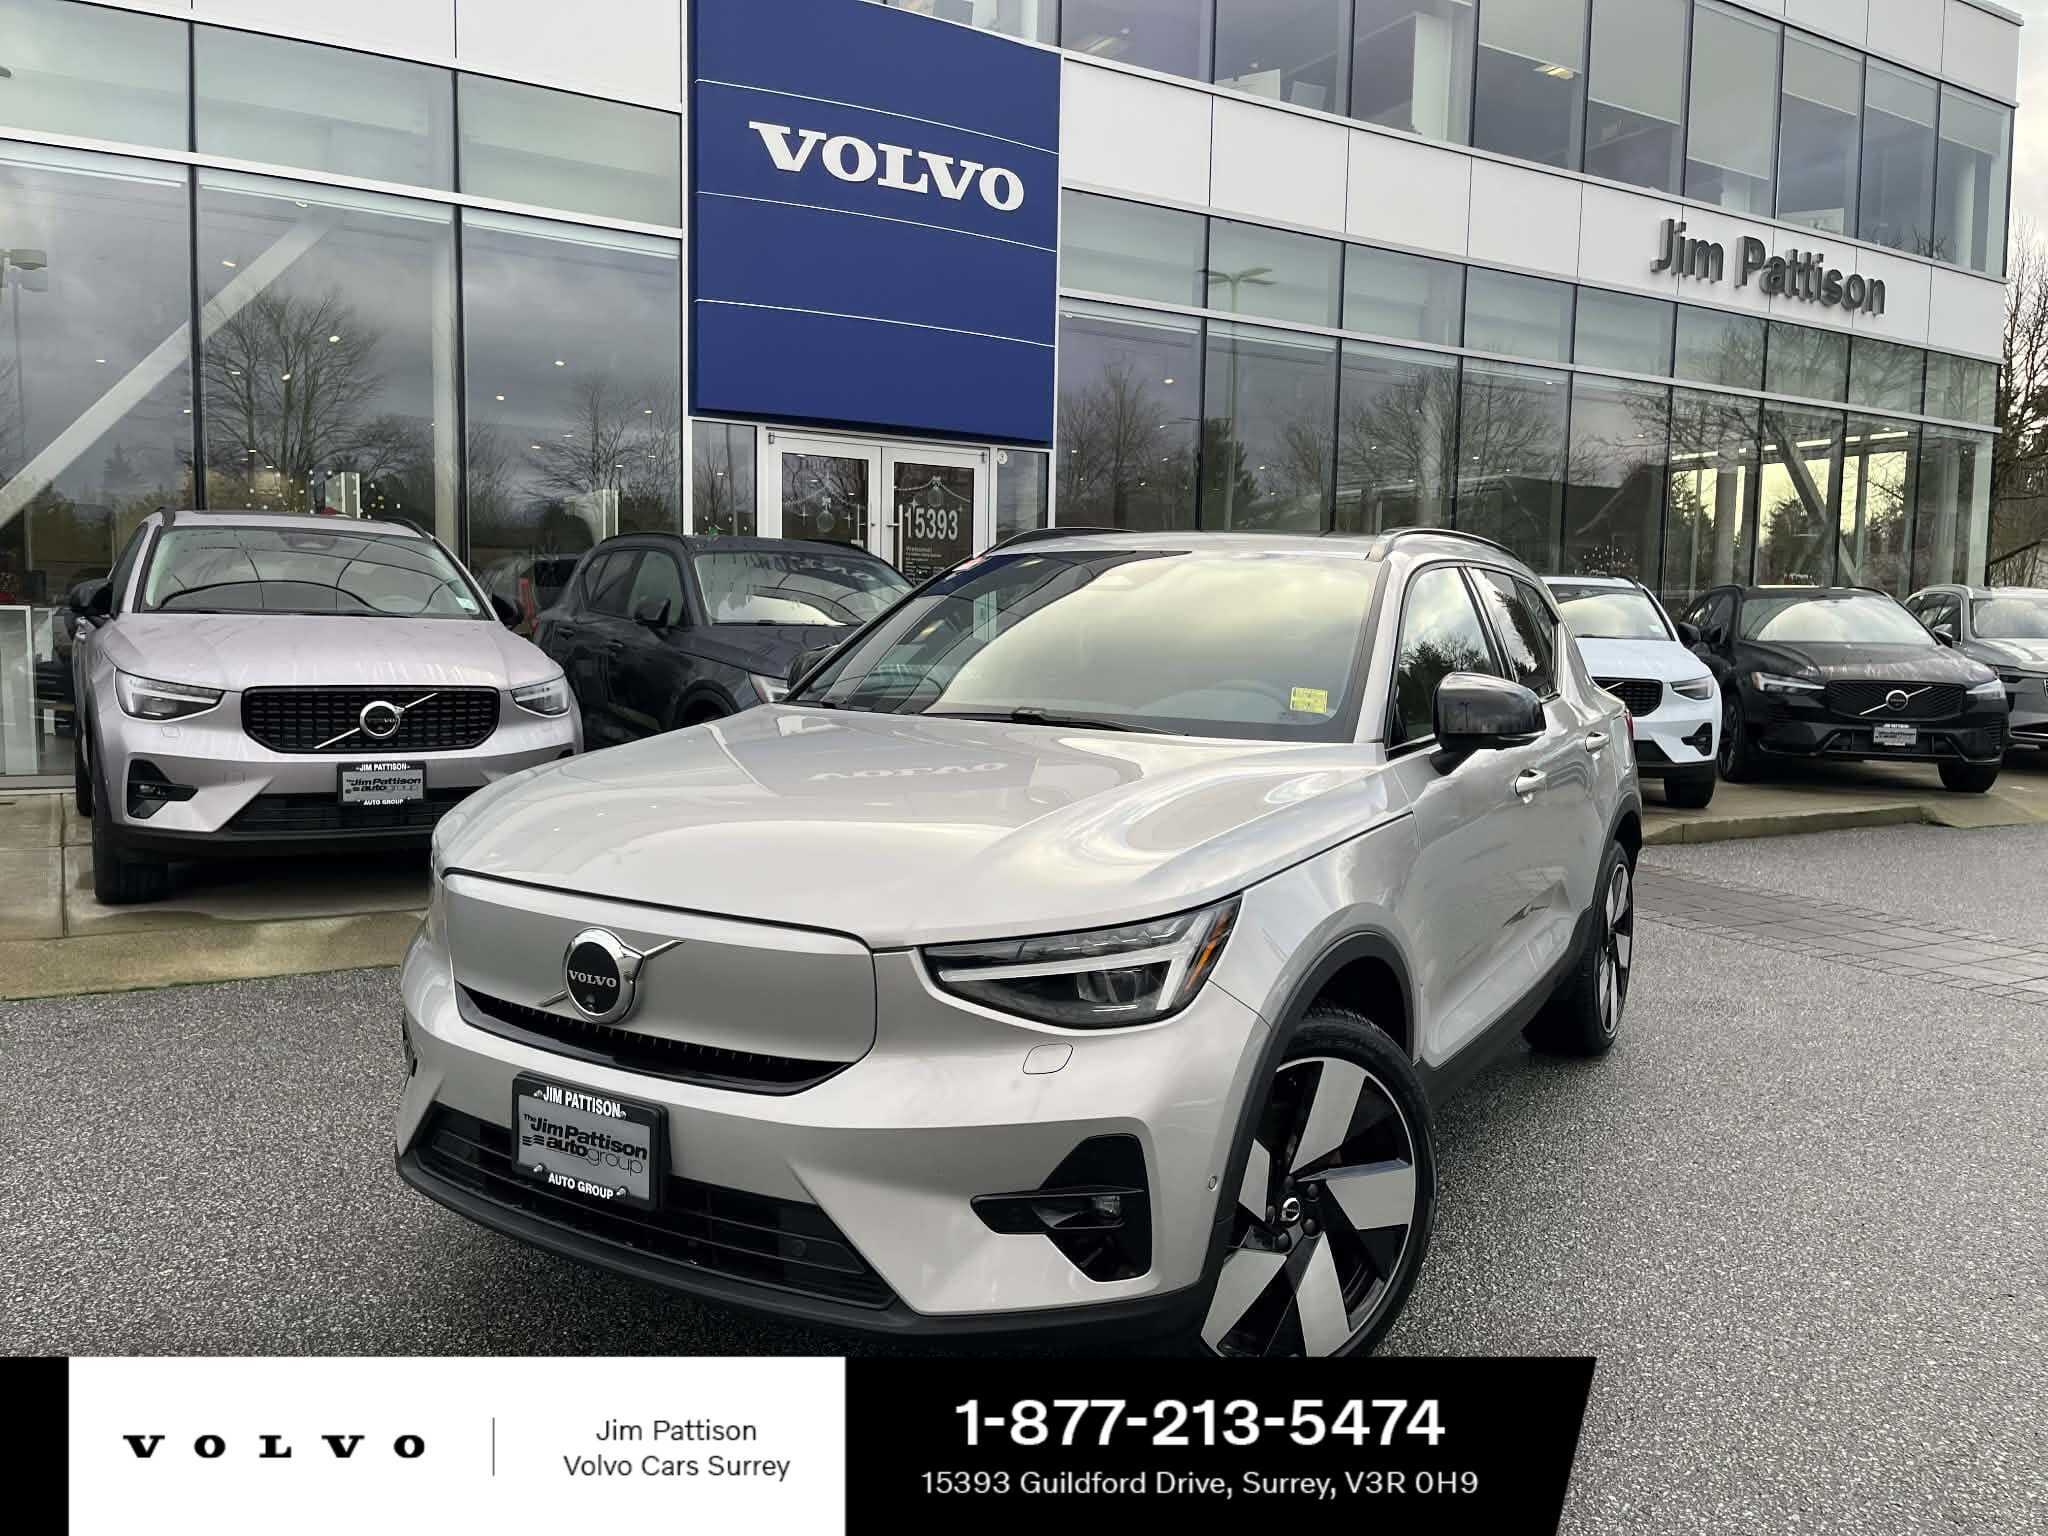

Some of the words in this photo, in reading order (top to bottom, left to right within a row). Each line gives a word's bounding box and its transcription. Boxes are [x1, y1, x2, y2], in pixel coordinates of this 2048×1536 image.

[748, 120, 1025, 211] VOLVO
[1649, 218, 1724, 284] Jim
[1733, 235, 1886, 317] Pattison
[904, 508, 959, 541] 15393
[359, 763, 373, 771] JIM
[373, 762, 407, 771] PATTISON
[568, 969, 617, 988] VOLVO
[543, 1085, 563, 1105] JIM
[565, 1091, 621, 1118] PATTISON
[548, 1172, 576, 1190] AUTO
[577, 1181, 614, 1200] GROUP
